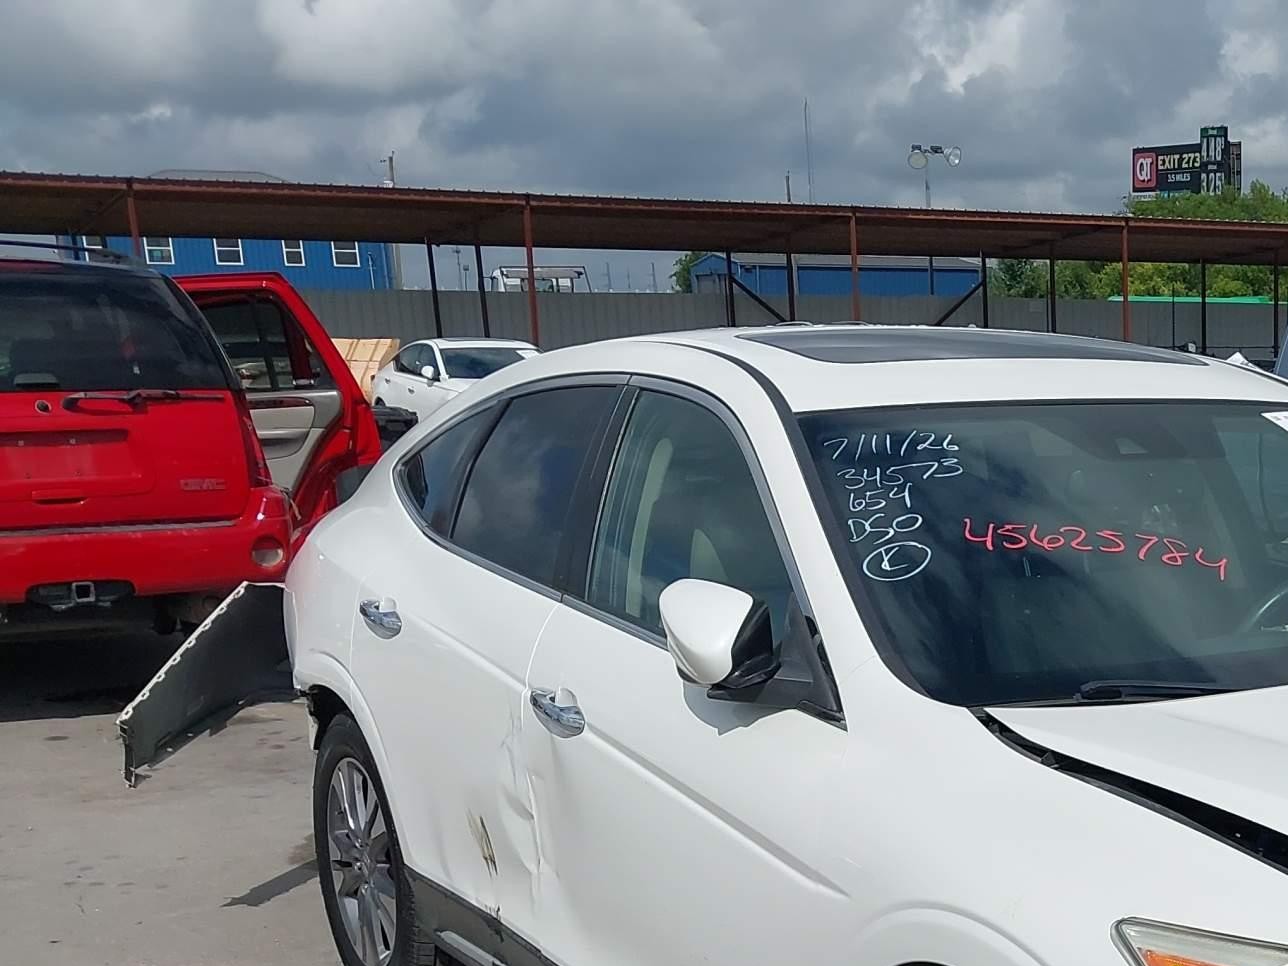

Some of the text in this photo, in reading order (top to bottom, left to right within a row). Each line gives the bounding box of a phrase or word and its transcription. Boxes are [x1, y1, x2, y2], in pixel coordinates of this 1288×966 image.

[1136, 157, 1153, 184] QT
[1157, 154, 1180, 170] EXIT
[1181, 152, 1201, 168] 273
[1176, 173, 1191, 182] MILES
[823, 430, 960, 460] 7/11/26
[837, 458, 964, 490] 34573
[849, 482, 913, 512] 654
[963, 517, 1230, 582] 45625784
